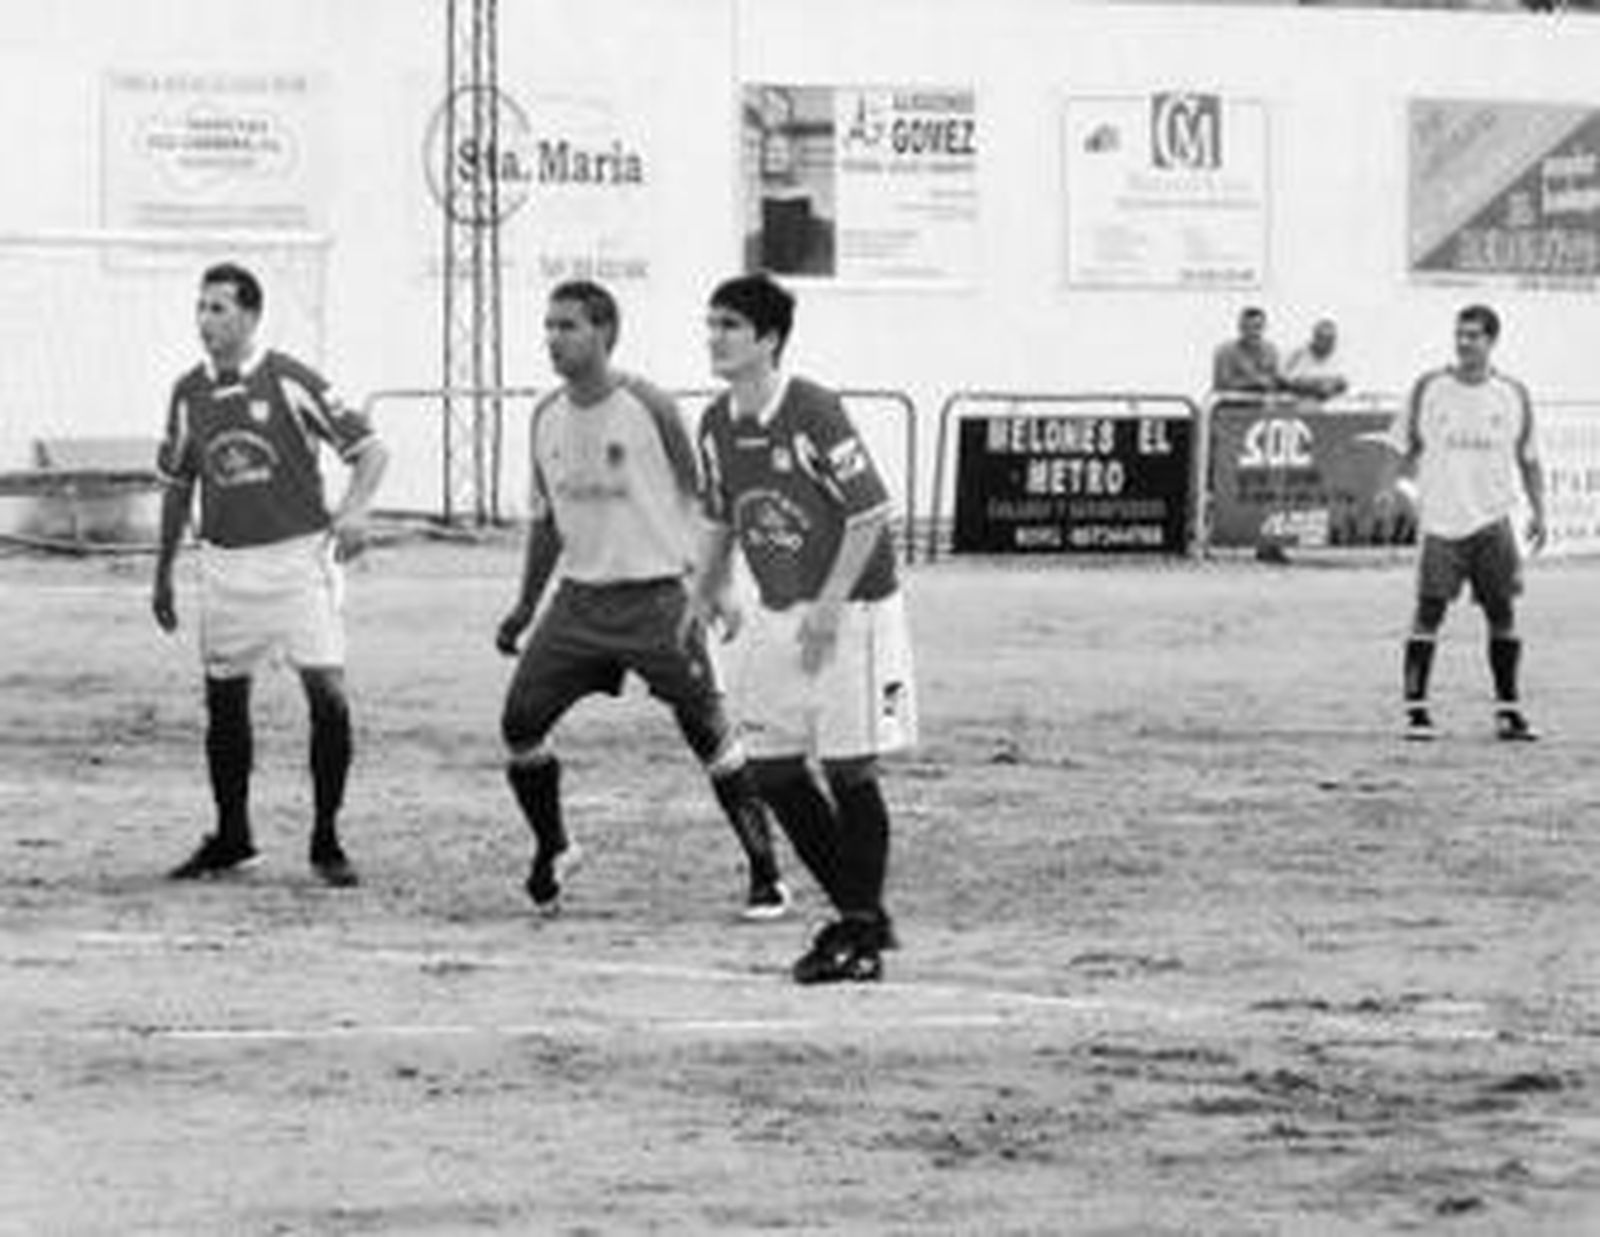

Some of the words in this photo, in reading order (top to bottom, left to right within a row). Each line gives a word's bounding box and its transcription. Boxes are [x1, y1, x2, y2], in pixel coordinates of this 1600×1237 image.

[987, 418, 1115, 454] MELONES
[1138, 418, 1171, 454] EL
[1027, 458, 1124, 494] METRO
